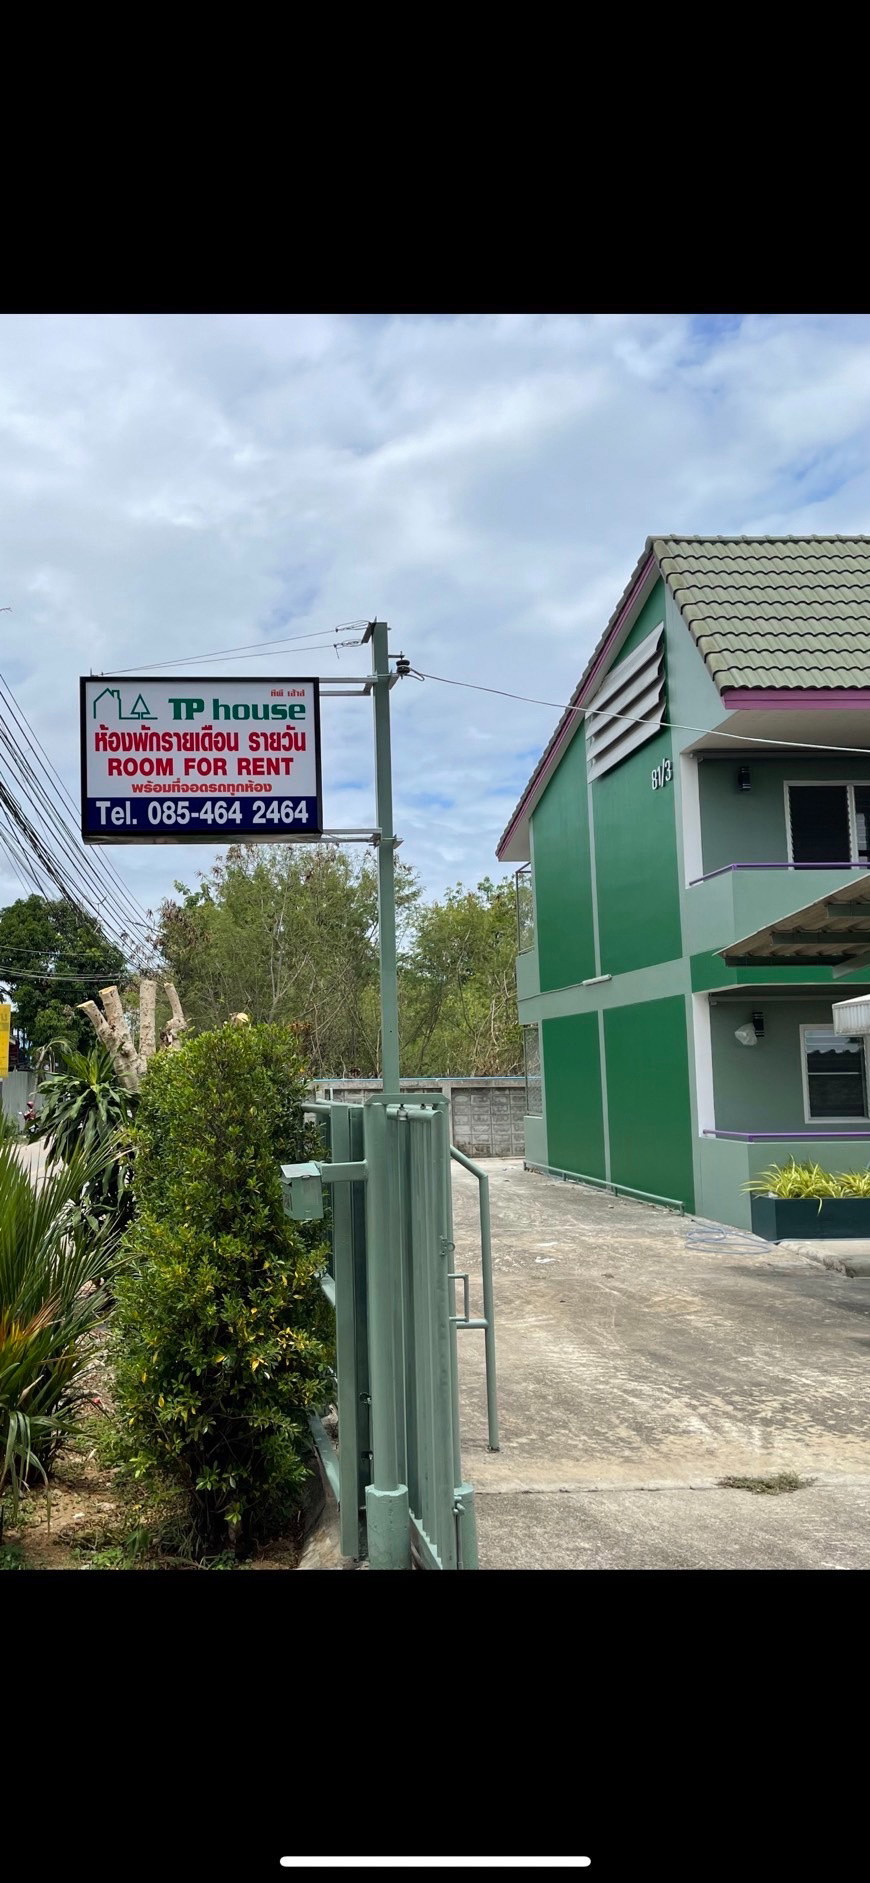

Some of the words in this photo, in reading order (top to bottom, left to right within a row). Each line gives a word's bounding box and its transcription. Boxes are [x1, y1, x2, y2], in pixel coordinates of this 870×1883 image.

[168, 698, 205, 720] TP
[213, 698, 306, 720] house
[94, 724, 239, 752] ห้องพักรายเดือน
[248, 725, 306, 752] รายวัน
[107, 757, 174, 777] ROOM
[183, 757, 228, 776] FOR
[237, 757, 294, 776] RENT
[651, 758, 673, 790] 81/3
[131, 778, 273, 796] พร้อมที่จอดรถทุกห้อง
[95, 800, 138, 825] Tel.
[147, 800, 243, 825] 085-464
[252, 800, 309, 825] 2464
